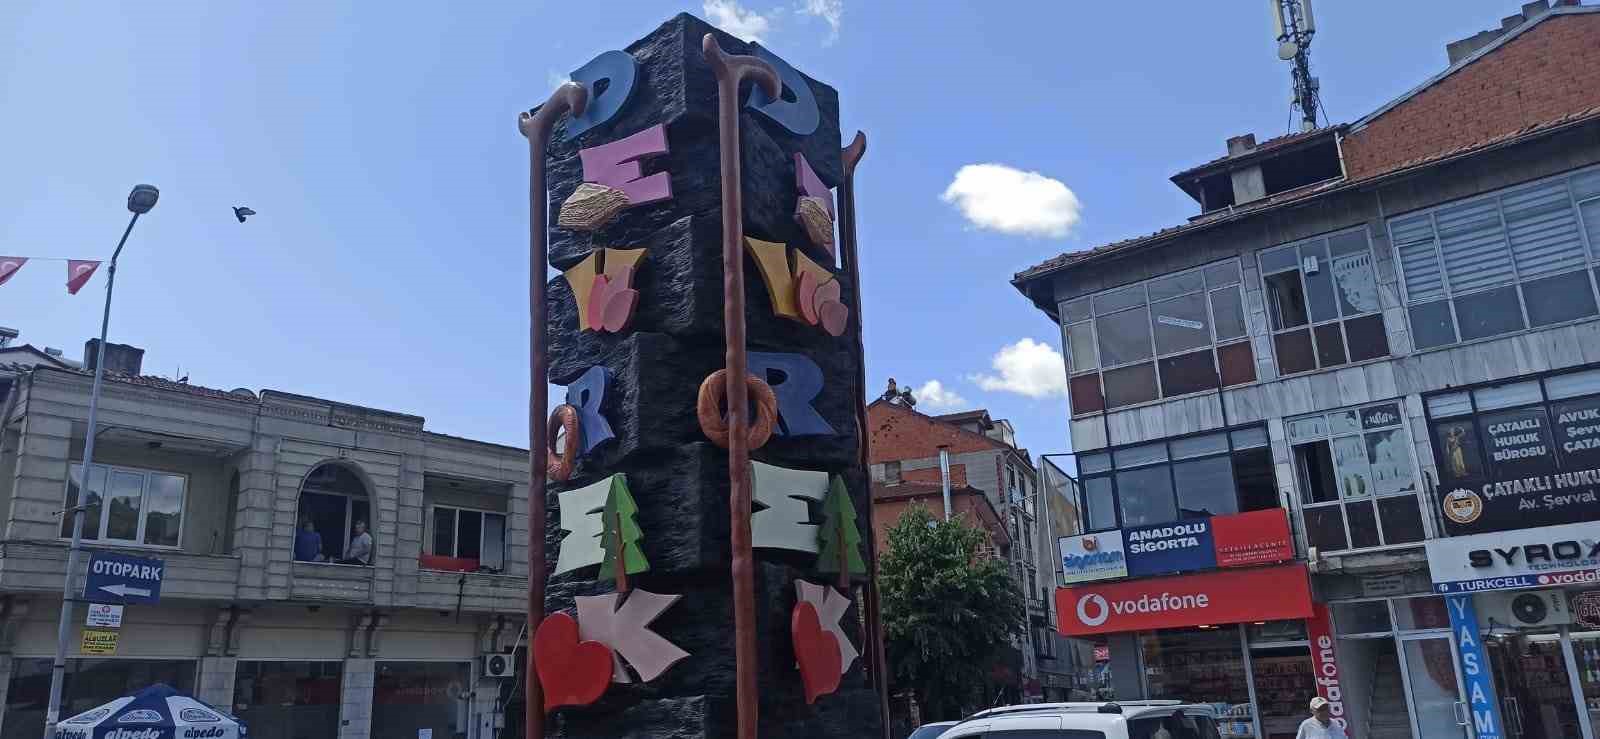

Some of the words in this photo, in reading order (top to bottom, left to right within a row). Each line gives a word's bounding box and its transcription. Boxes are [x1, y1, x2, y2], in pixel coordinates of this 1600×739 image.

[1488, 418, 1540, 436] ÇATAKLI
[1495, 432, 1540, 447] HUKUK
[1493, 445, 1547, 461] BÜROSU
[1482, 475, 1552, 500] ÇATAKLI
[1543, 490, 1597, 510] Şevval
[1129, 522, 1206, 542] ANADOLU
[1129, 536, 1200, 554] SİGORTA
[93, 559, 161, 581] OTOPARK
[1528, 558, 1600, 571] TECHNOLOG
[1456, 576, 1532, 592] TURKCELL
[1112, 592, 1209, 615] vodafone
